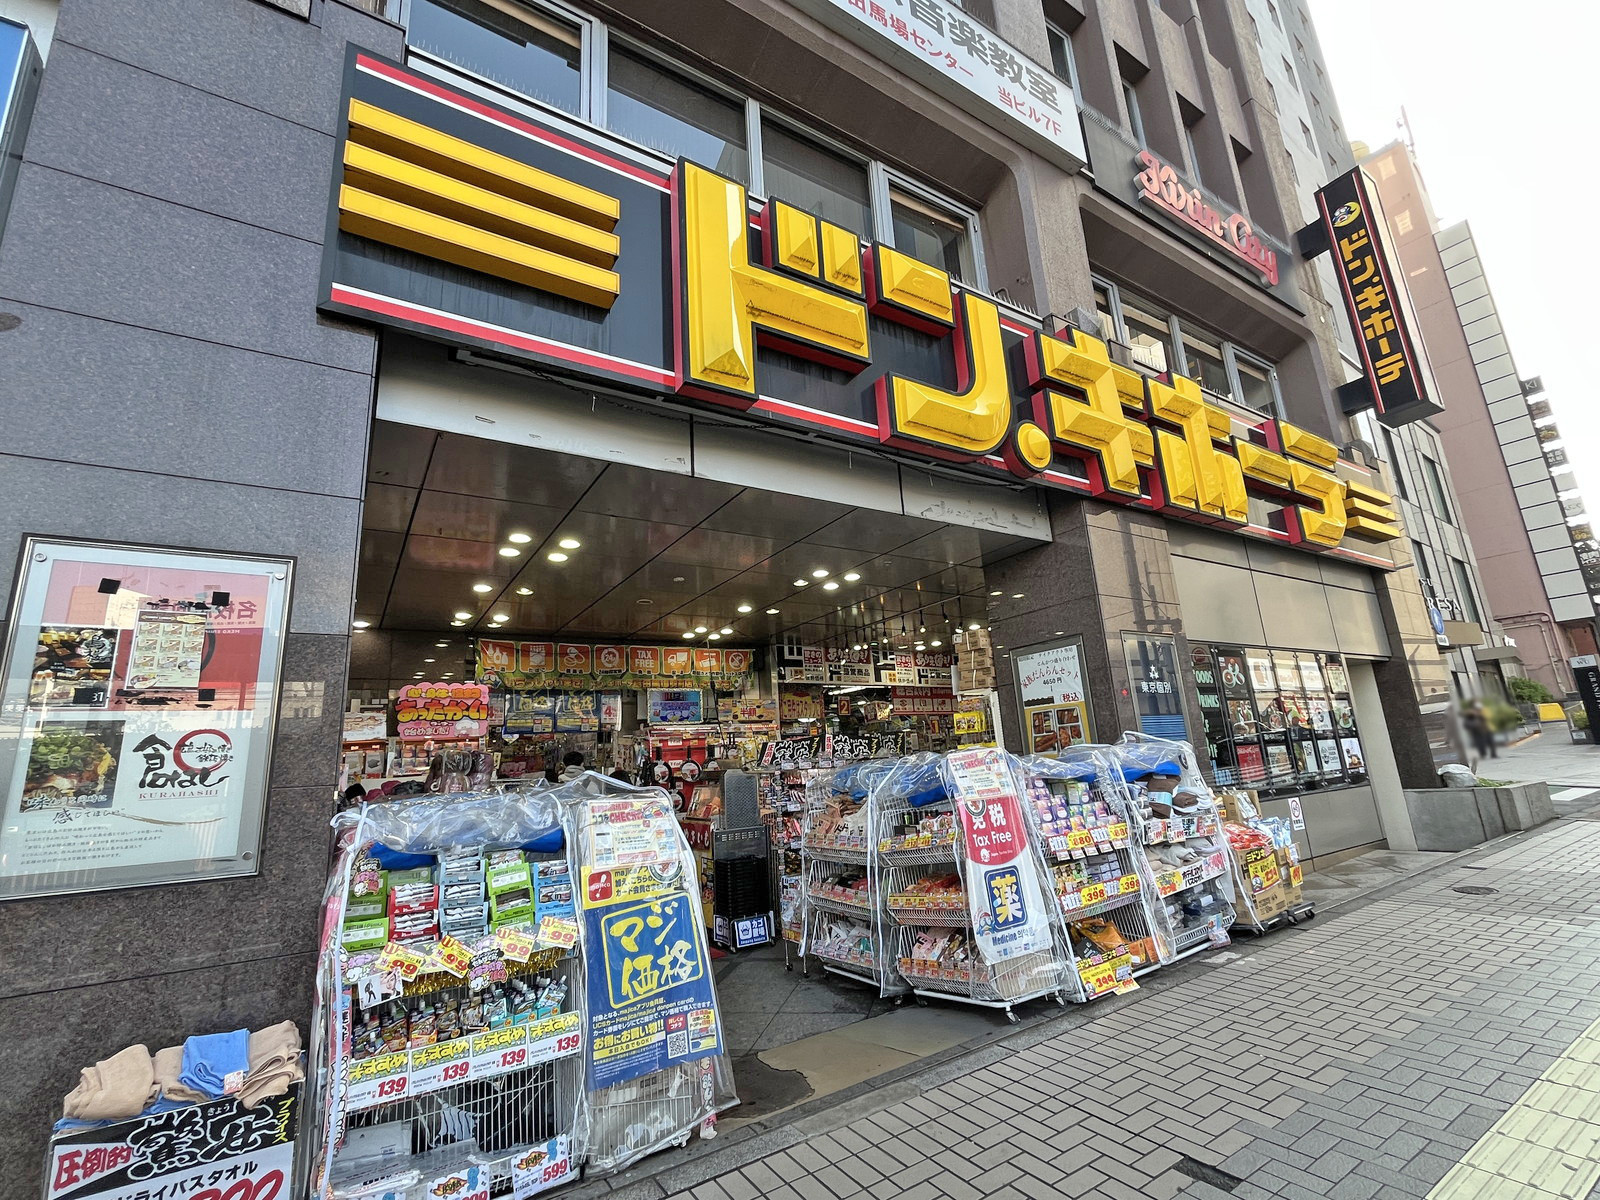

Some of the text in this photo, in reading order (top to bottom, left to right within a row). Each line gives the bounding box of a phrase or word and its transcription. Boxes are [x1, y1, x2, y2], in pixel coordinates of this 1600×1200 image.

[895, 0, 1062, 115] 音楽教室
[997, 85, 1062, 136] 当ビル7F
[637, 650, 652, 659] TAX
[635, 659, 655, 668] FREE
[1043, 677, 1062, 685] 4650円
[1193, 670, 1213, 683] OODS
[1140, 681, 1172, 694] 東京個別
[1062, 692, 1080, 702] 税込
[139, 789, 219, 799] KURAHASHI
[973, 831, 1012, 847] Tax Free
[1072, 835, 1092, 846] 880
[1124, 879, 1140, 890] 398
[991, 872, 1022, 923] 薬
[1087, 889, 1105, 902] 398
[610, 901, 678, 952] マジ
[752, 918, 763, 928] カゴ
[550, 931, 574, 943] 99
[992, 932, 1017, 946] Medicine
[506, 942, 528, 955] 99
[444, 953, 468, 971] 99
[621, 940, 697, 999] 価格
[1096, 974, 1115, 988] 399
[557, 1034, 580, 1052] 139
[608, 1037, 652, 1055] 本日入会でもOK!
[501, 1048, 526, 1068] 139
[443, 1061, 470, 1083] 139
[377, 1076, 407, 1098] 139
[207, 1103, 230, 1116] きょう
[272, 1096, 296, 1143] プライス
[53, 1146, 132, 1191] 圧倒的
[543, 1159, 568, 1183] 599
